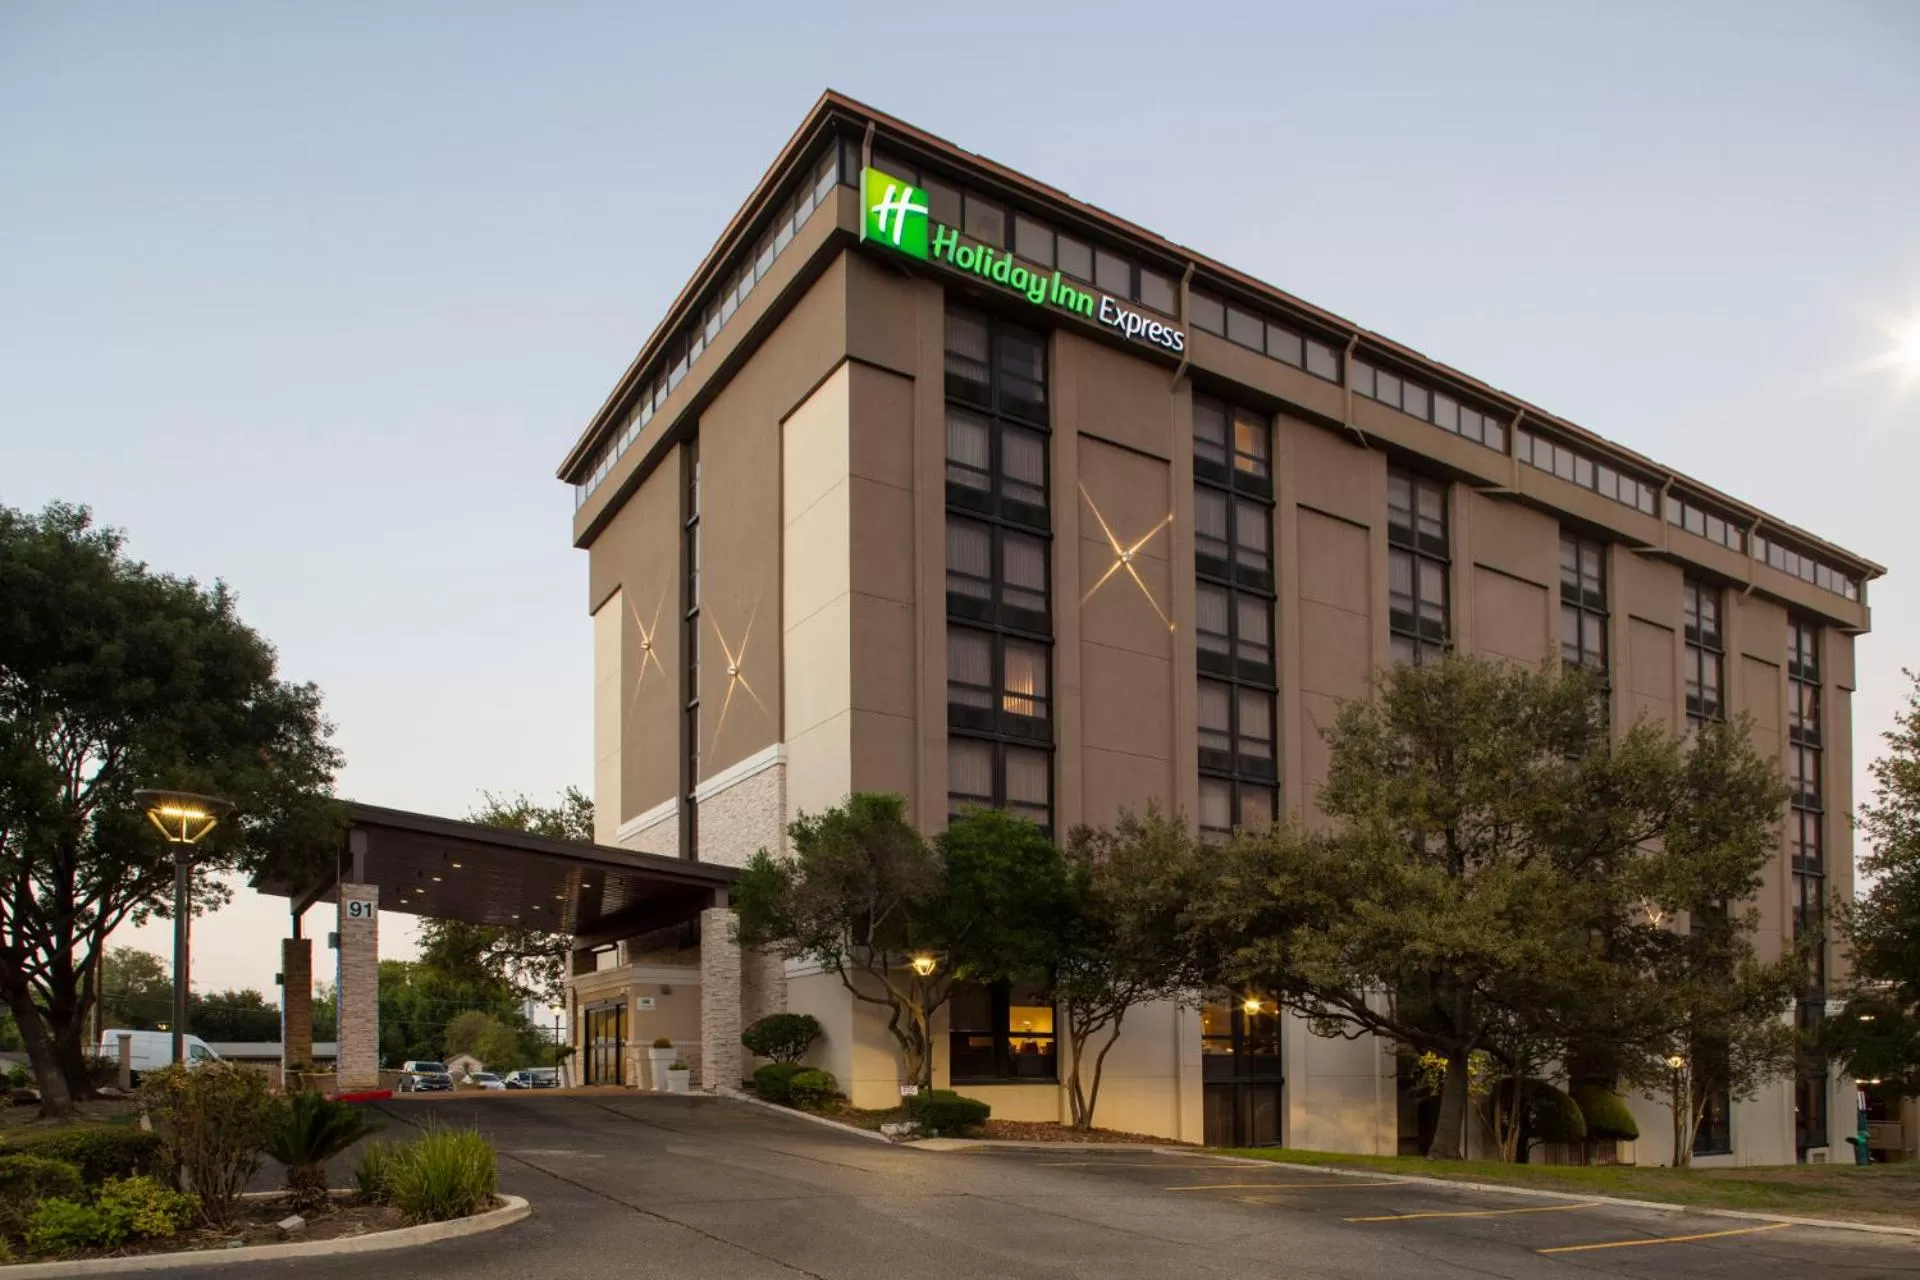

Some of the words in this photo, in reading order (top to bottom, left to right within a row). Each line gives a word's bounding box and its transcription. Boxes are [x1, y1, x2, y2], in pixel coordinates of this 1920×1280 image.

[871, 183, 928, 246] H
[932, 224, 1048, 304] Holiday
[1050, 271, 1094, 317] Inn
[1098, 295, 1185, 352] Express
[350, 901, 372, 918] 91
